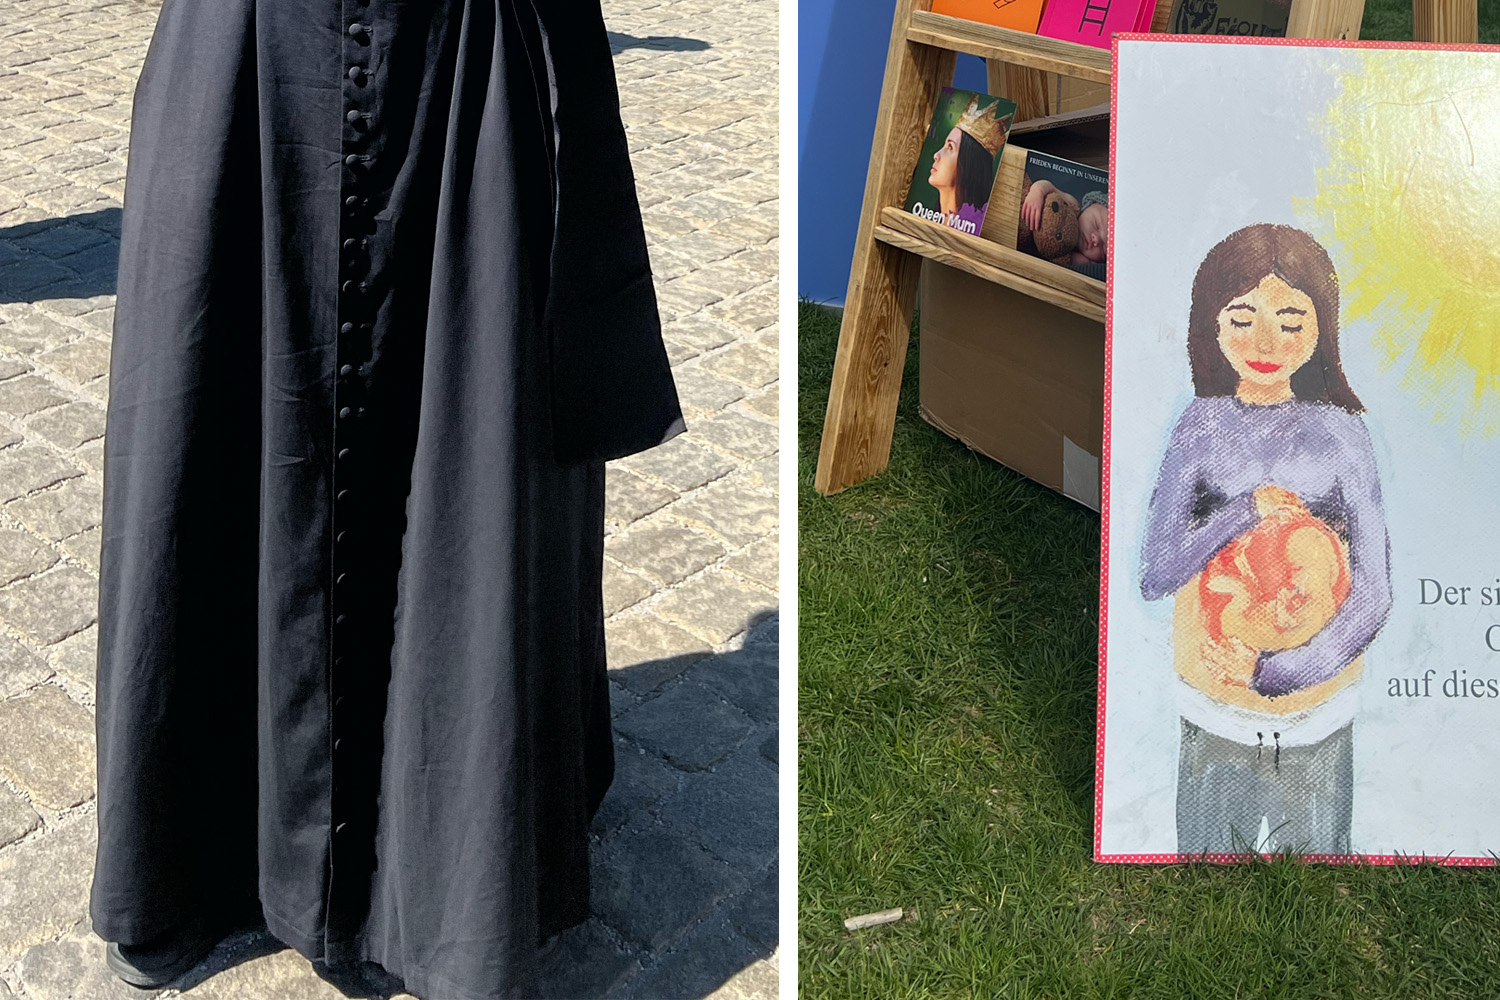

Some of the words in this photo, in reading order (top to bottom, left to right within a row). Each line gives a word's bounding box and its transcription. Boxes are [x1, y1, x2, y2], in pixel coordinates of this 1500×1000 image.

[1029, 156, 1052, 169] FRIEDEN
[1052, 162, 1077, 177] BEGINNT
[1077, 168, 1084, 178] IN
[912, 201, 946, 225] Queen
[949, 212, 976, 234] Mum
[1418, 578, 1471, 606] Der
[1387, 669, 1436, 698] auf
